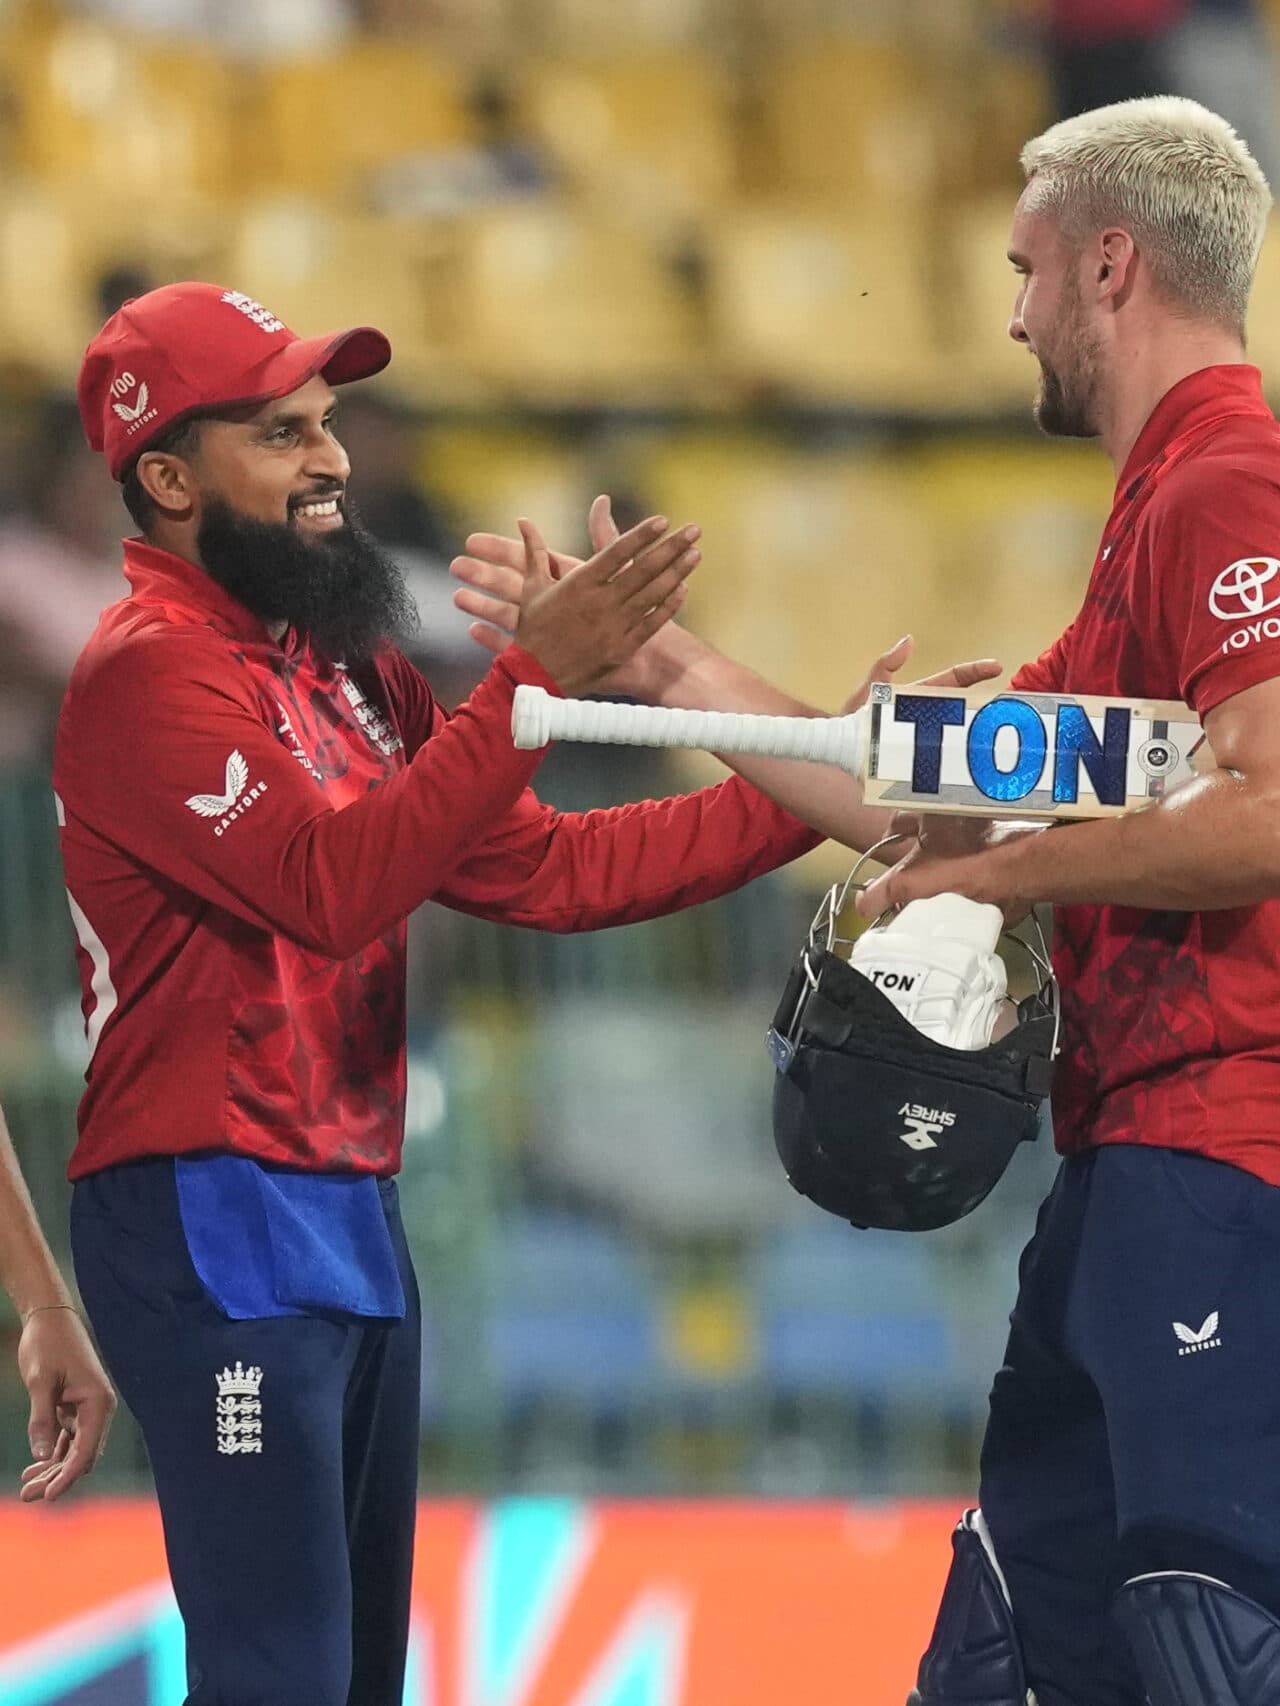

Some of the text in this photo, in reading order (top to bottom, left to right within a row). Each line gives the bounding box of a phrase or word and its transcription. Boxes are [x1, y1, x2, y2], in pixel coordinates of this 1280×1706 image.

[109, 371, 136, 399] 100
[894, 693, 1132, 807] TON
[213, 780, 269, 837] CASTORE
[872, 971, 915, 992] TON
[897, 1102, 957, 1127] SHREY
[1178, 1338, 1222, 1356] CASTORE
